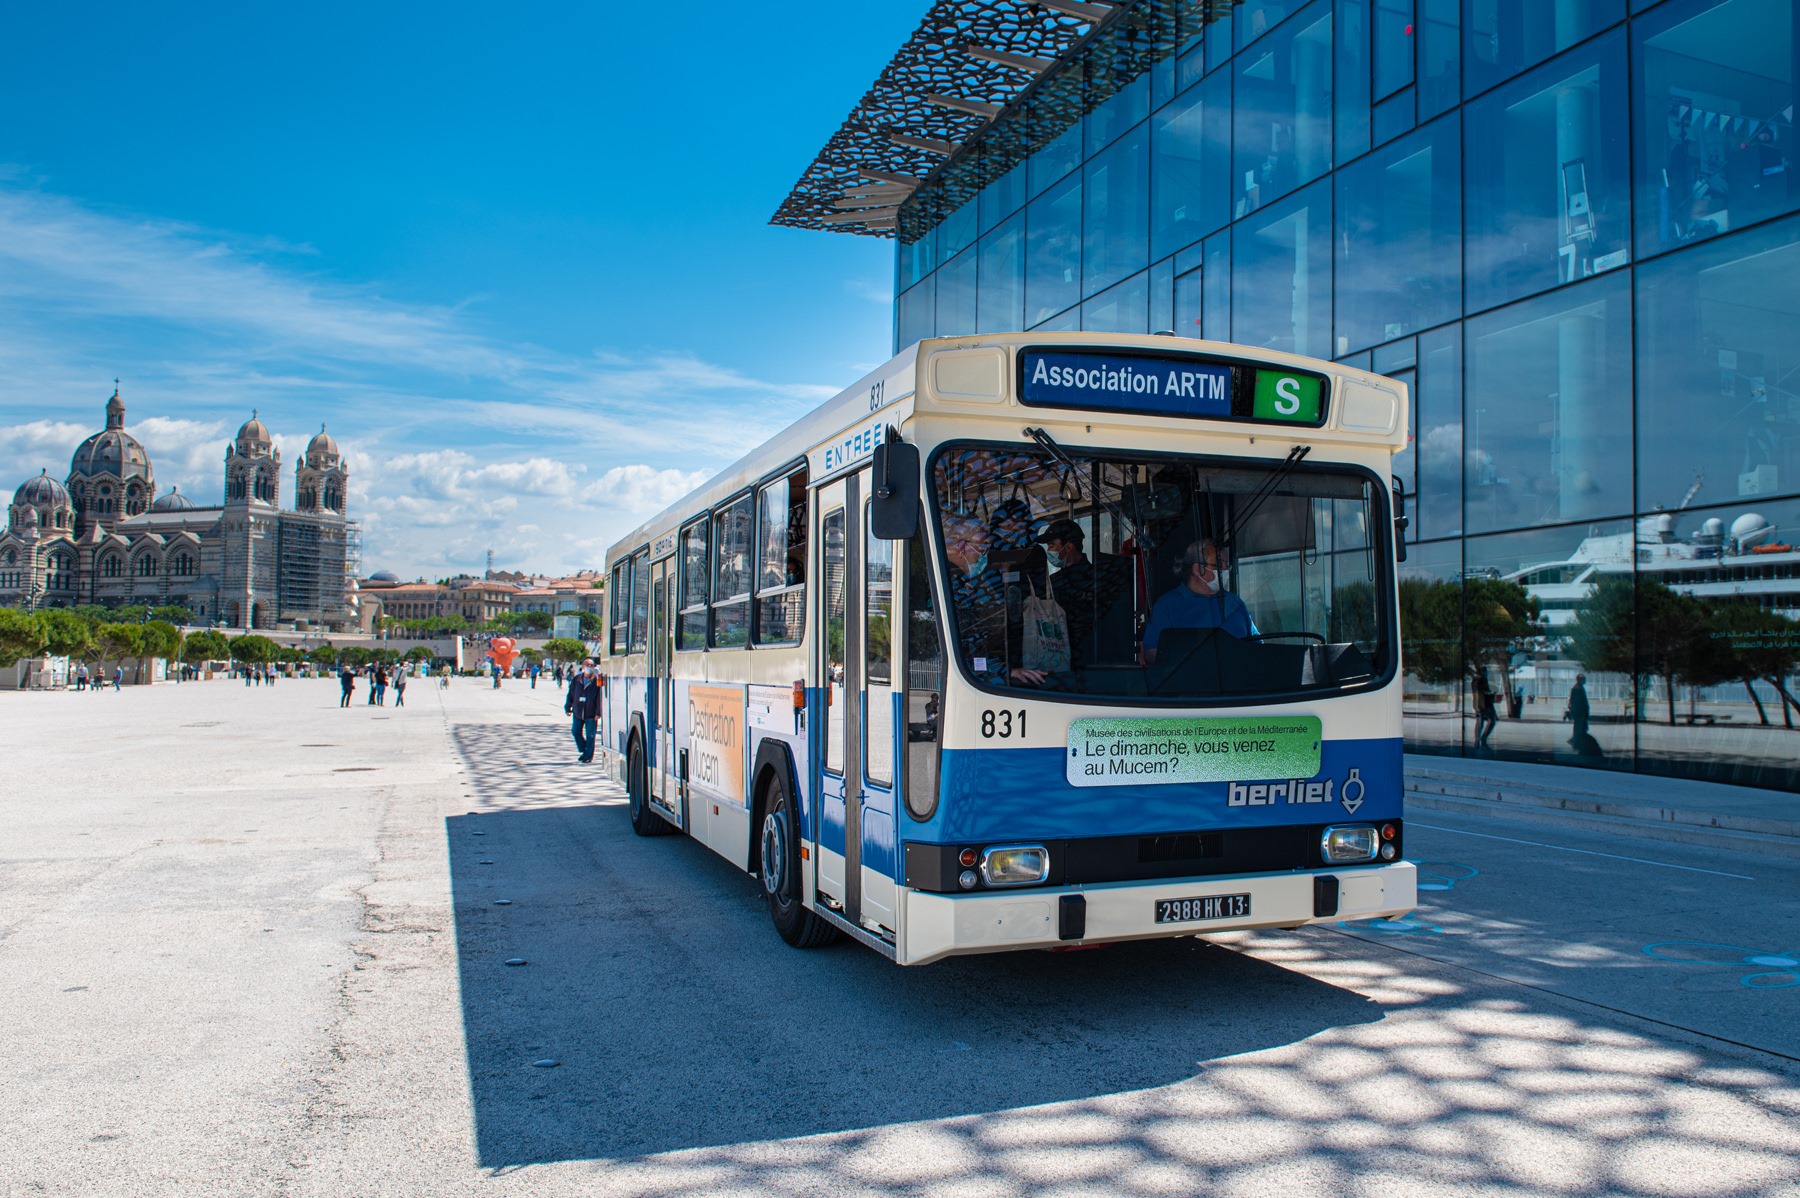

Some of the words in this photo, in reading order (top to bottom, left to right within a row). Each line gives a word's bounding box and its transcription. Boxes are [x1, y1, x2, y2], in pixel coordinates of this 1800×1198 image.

[1032, 358, 1158, 395] Association
[1164, 371, 1225, 400] ARTM
[870, 380, 885, 411] 831
[1274, 377, 1300, 415] S
[826, 422, 881, 470] ENTREE
[690, 700, 735, 748] Destination
[981, 709, 1028, 738] 831
[1086, 728, 1115, 738] Musée
[1116, 729, 1132, 738] des
[1134, 728, 1181, 737] civilisations
[1182, 728, 1193, 736] de
[1194, 726, 1226, 737] l'Europe
[1228, 726, 1236, 735] et
[1237, 726, 1248, 735] de
[1249, 726, 1256, 734] la
[1258, 724, 1308, 734] Méditerranée
[690, 738, 719, 786] Mucem
[1086, 741, 1105, 756] Le
[1110, 740, 1190, 757] dimanche,
[1194, 741, 1230, 754] vous
[1232, 740, 1275, 753] venez
[1084, 762, 1104, 776] au
[1110, 758, 1179, 775] Mucem?
[1227, 778, 1334, 807] berliet
[1162, 900, 1200, 922] 2988
[1204, 898, 1222, 918] HK
[1228, 896, 1244, 916] 13
